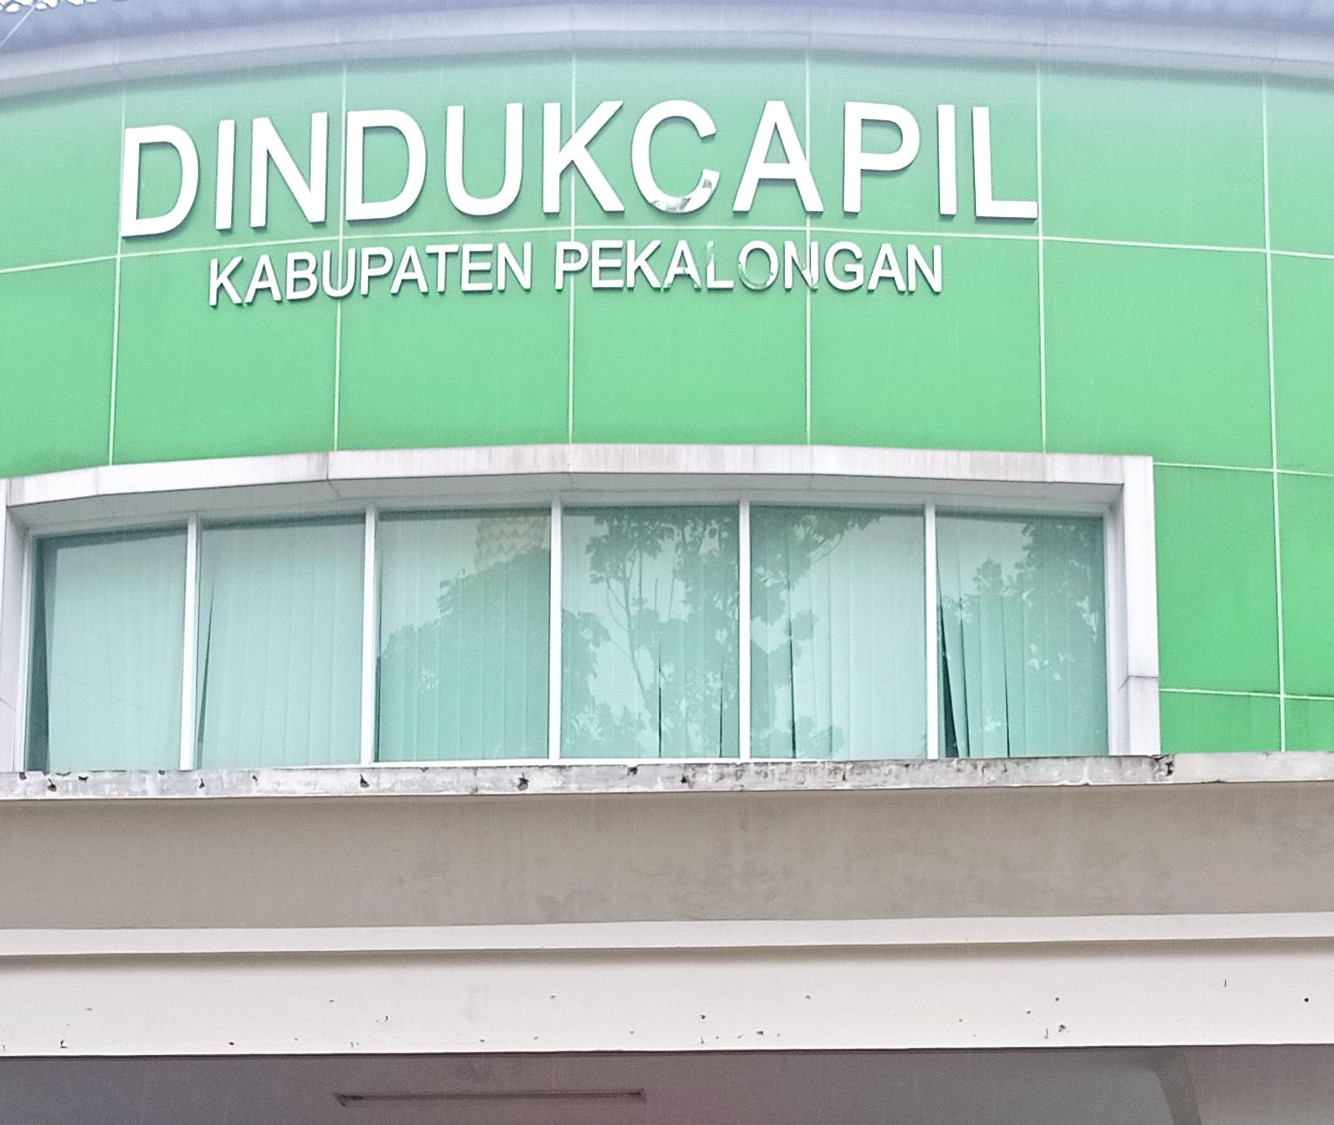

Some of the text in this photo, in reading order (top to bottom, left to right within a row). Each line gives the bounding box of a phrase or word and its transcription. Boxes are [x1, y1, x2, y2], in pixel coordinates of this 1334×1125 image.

[119, 99, 1040, 238] DINDUKCAPIL
[208, 239, 943, 306] KABUPATEN PEKALONGAN
